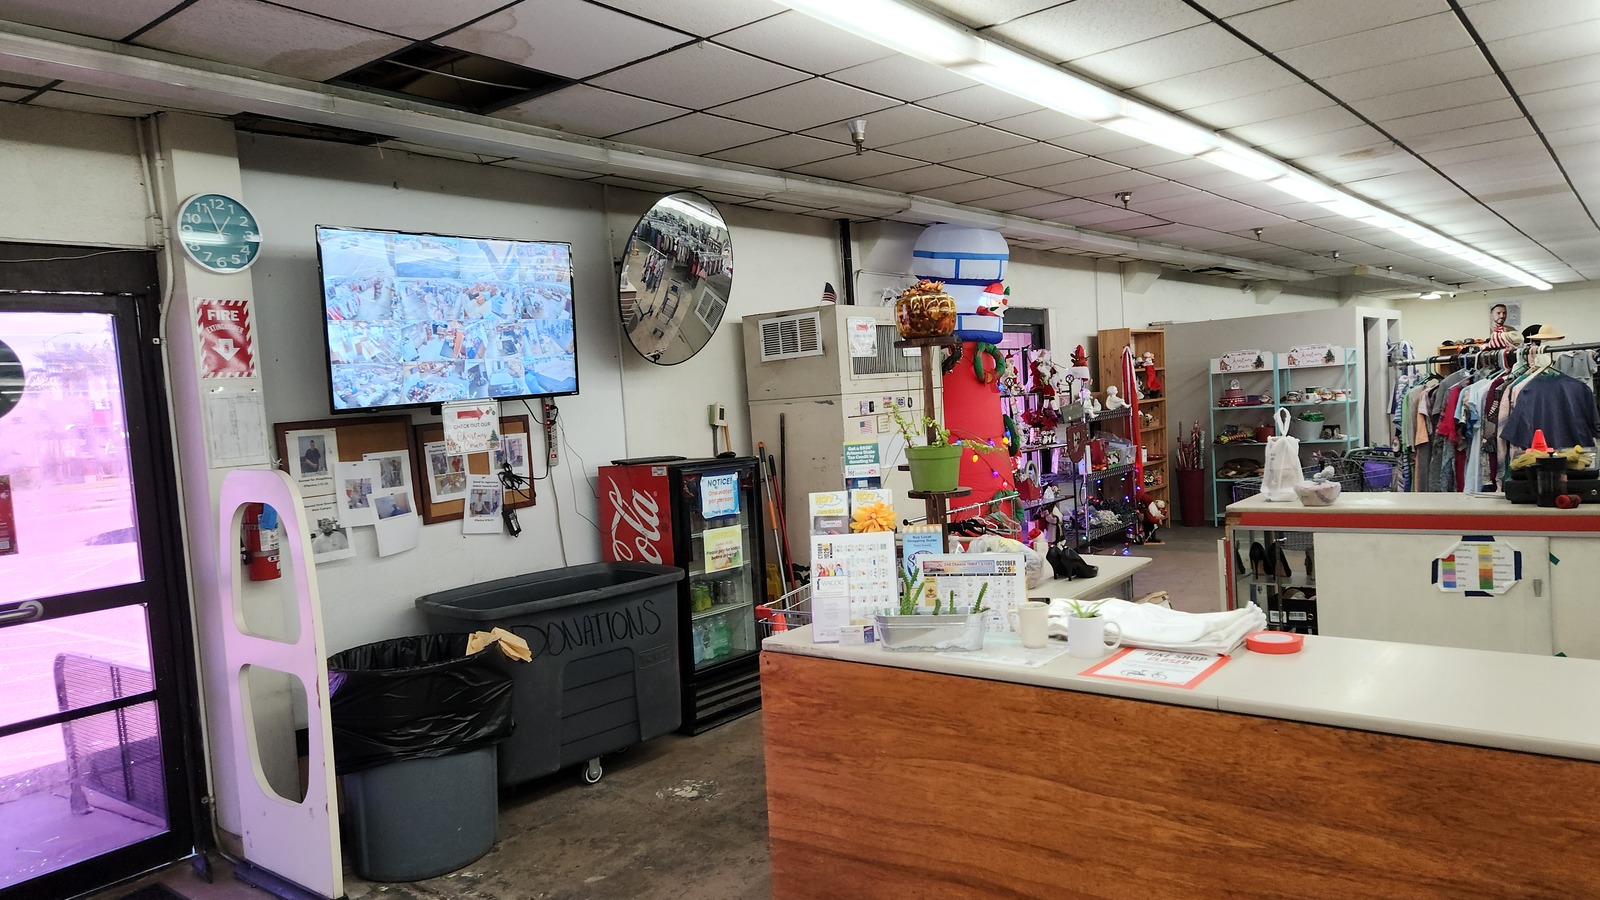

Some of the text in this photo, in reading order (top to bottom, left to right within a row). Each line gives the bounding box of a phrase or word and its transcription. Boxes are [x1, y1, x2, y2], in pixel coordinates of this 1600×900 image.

[194, 202, 208, 214] 11
[208, 199, 225, 210] 12
[228, 204, 234, 215] 1
[185, 213, 202, 224] 10
[239, 216, 249, 227] 2
[240, 245, 251, 256] 4
[203, 251, 213, 262] 7
[231, 254, 241, 265] 5
[216, 257, 228, 268] 6
[207, 309, 240, 321] FIRE
[205, 323, 245, 334] EXTINGUISHER
[457, 430, 487, 442] Christmas
[707, 477, 733, 487] NOTICE!
[717, 496, 734, 504] person
[510, 599, 661, 661] DONATIONS
[1146, 657, 1191, 665] CLOSED
[1175, 652, 1208, 661] SHOP
